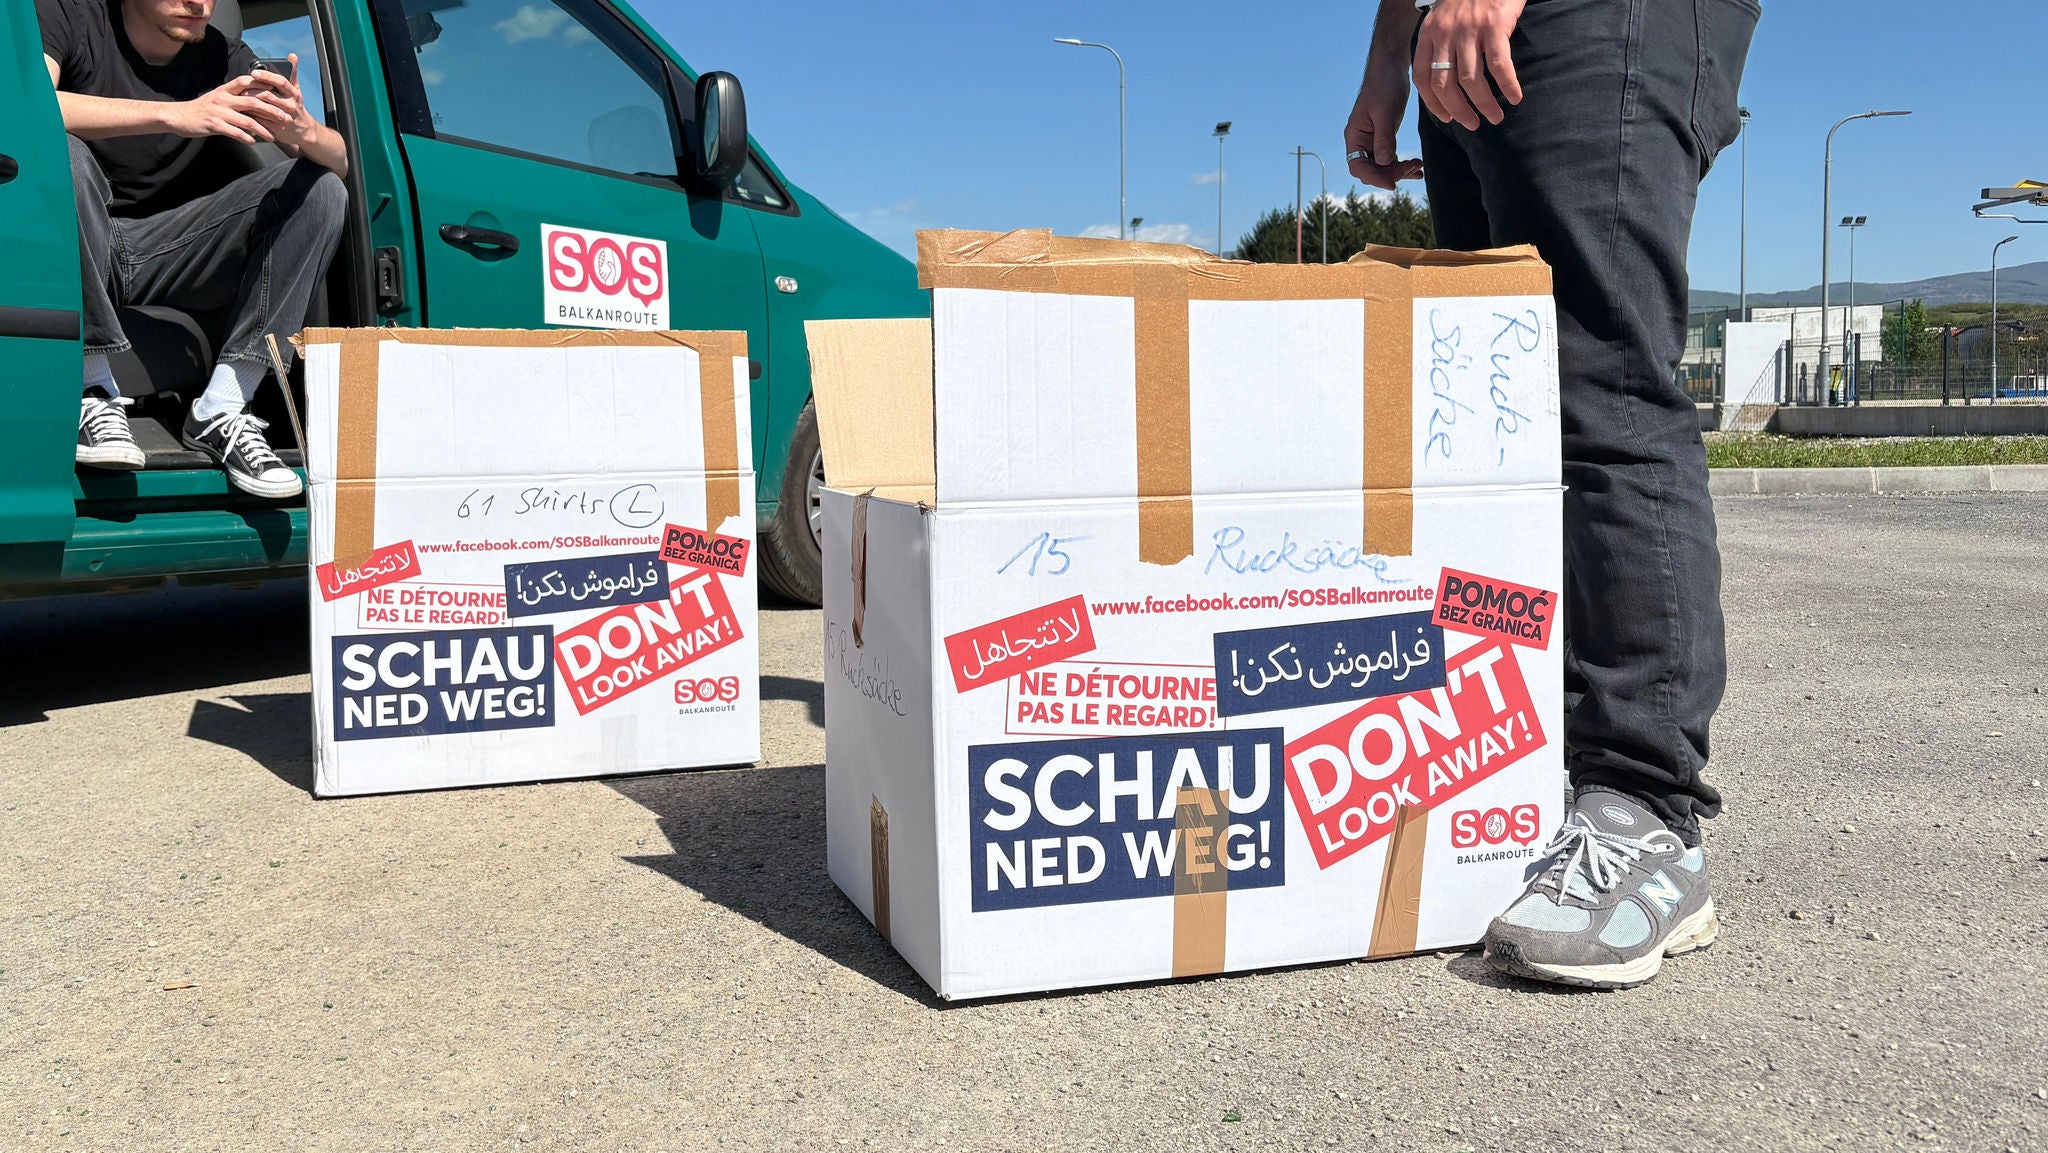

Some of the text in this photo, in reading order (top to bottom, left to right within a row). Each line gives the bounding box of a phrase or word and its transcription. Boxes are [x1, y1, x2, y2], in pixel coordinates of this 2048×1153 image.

[548, 231, 663, 300] SOS
[559, 305, 658, 325] BALKANROUTE
[457, 489, 495, 518] 61
[418, 534, 660, 554] www.facebook.com/SOSBalkanroute
[664, 547, 740, 571] BEZ GRANICA
[666, 528, 744, 559] POMOĆ
[997, 532, 1094, 576] 15
[367, 586, 506, 608] NE DÉTOURNE
[571, 561, 659, 600] فراموش
[1091, 585, 1434, 615] www.facebook.com/SOSBalkanroute
[1443, 576, 1549, 622] POMOĆ
[366, 608, 506, 625] PAS LE REGARD!
[558, 573, 715, 682] DON'T
[1439, 604, 1542, 641] BEZ GRANICA
[342, 635, 545, 691] SCHAU
[577, 616, 734, 706] LOOK AWAY!
[1308, 627, 1431, 689] فراموش
[674, 676, 740, 704] SOS
[1019, 667, 1217, 701] NE DÉTOURNE
[344, 684, 546, 729] NED WEG!
[679, 705, 736, 715] BALKANROUTE
[1018, 702, 1216, 728] PAS LE REGARD!
[1290, 645, 1507, 816] DON'T
[983, 744, 1271, 831] SCHAU
[1318, 711, 1533, 853] LOOK AWAY!
[1451, 804, 1540, 848] SOS
[986, 820, 1272, 891] NED WEG!
[1457, 848, 1535, 864] BALKANROUTE
[1638, 869, 1685, 917] N
